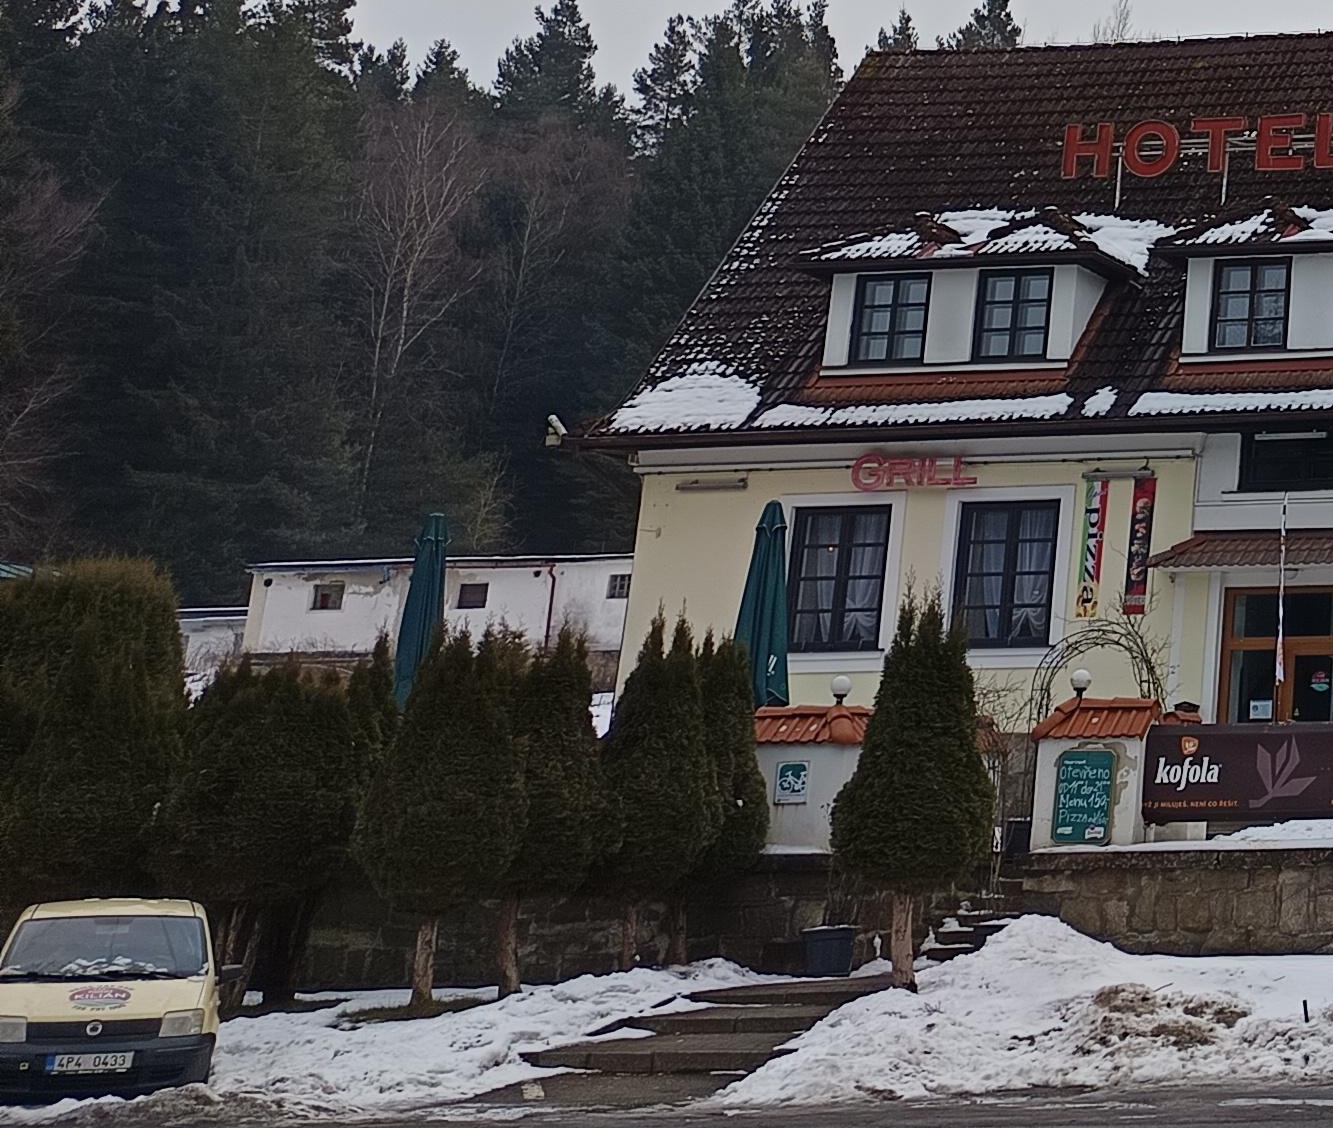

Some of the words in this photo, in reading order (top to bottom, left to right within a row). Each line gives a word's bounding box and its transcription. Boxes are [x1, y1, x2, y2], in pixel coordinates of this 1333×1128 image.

[1081, 506, 1104, 604] pizza
[1060, 765, 1110, 779] Otevřeno
[1154, 756, 1220, 791] kofola
[1058, 794, 1087, 809] Menu
[57, 1056, 82, 1069] 4P4
[92, 1054, 126, 1067] 0433
